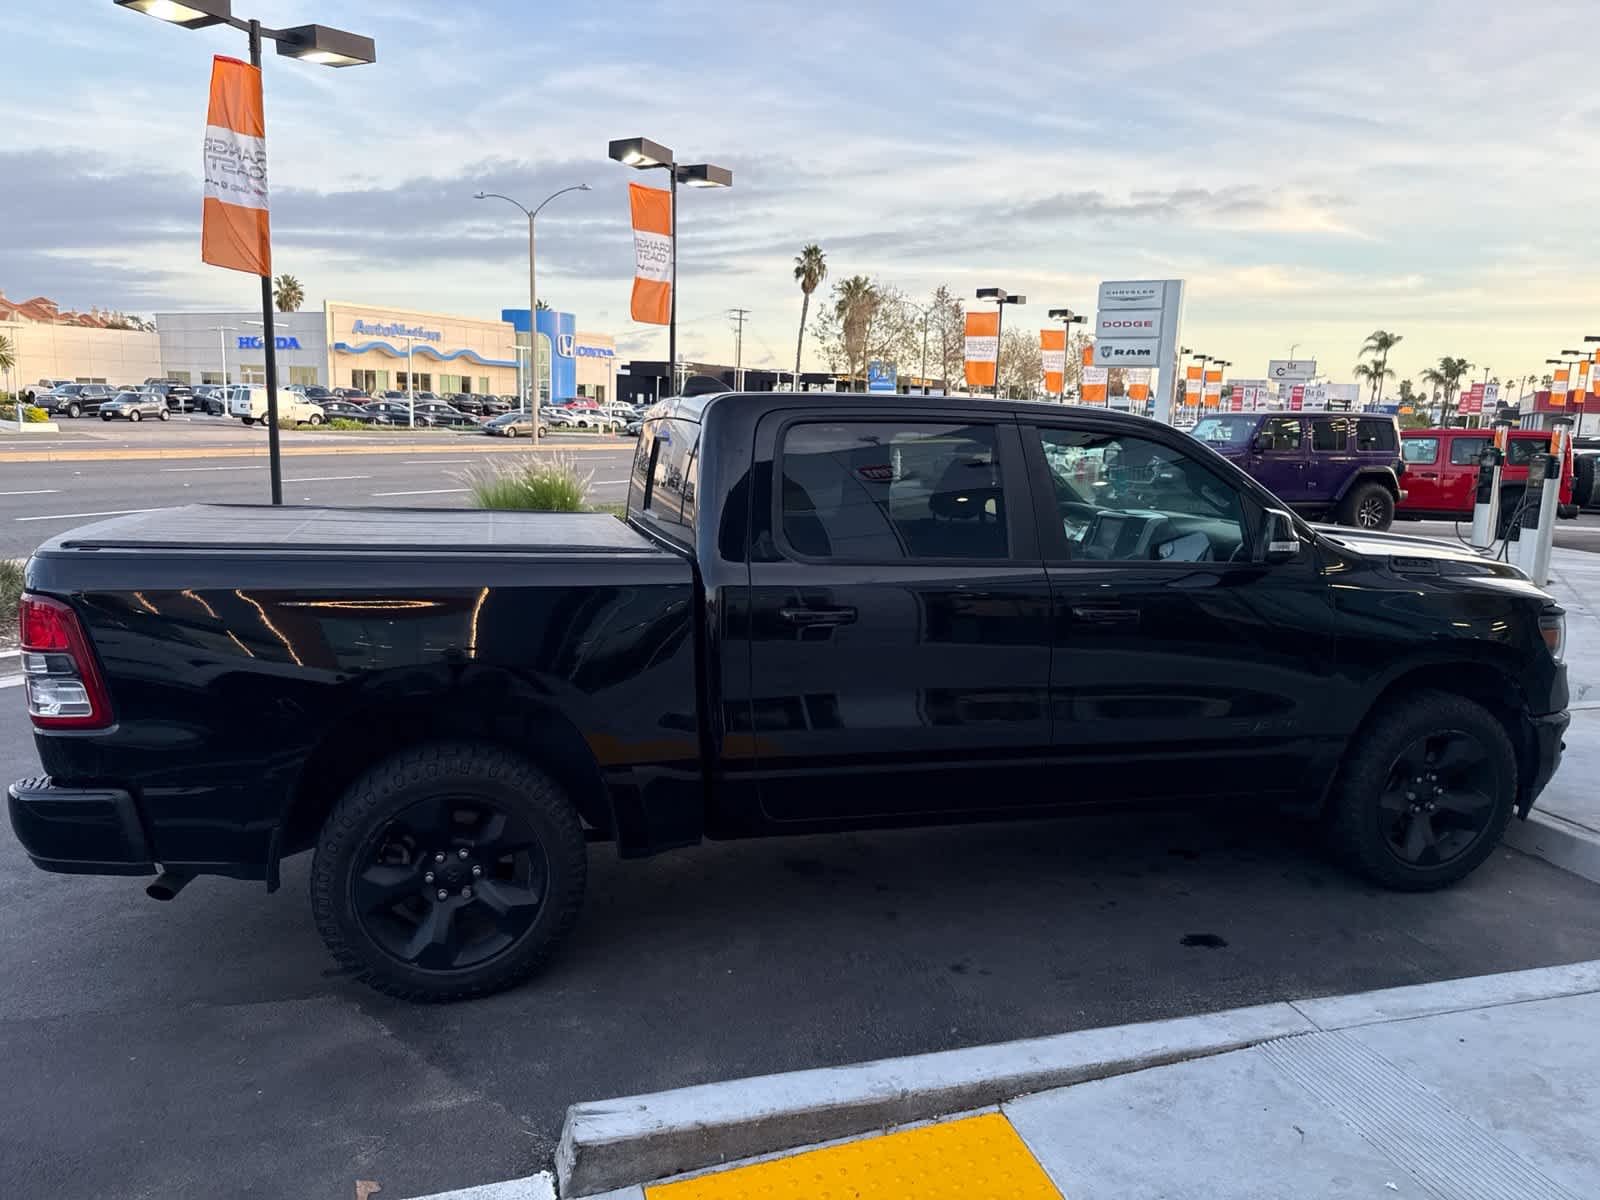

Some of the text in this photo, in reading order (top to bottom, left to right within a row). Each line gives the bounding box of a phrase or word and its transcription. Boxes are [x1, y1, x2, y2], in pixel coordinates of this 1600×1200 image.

[352, 319, 441, 342] AutoNation
[1102, 320, 1153, 328] DODGE
[238, 336, 302, 349] HODA
